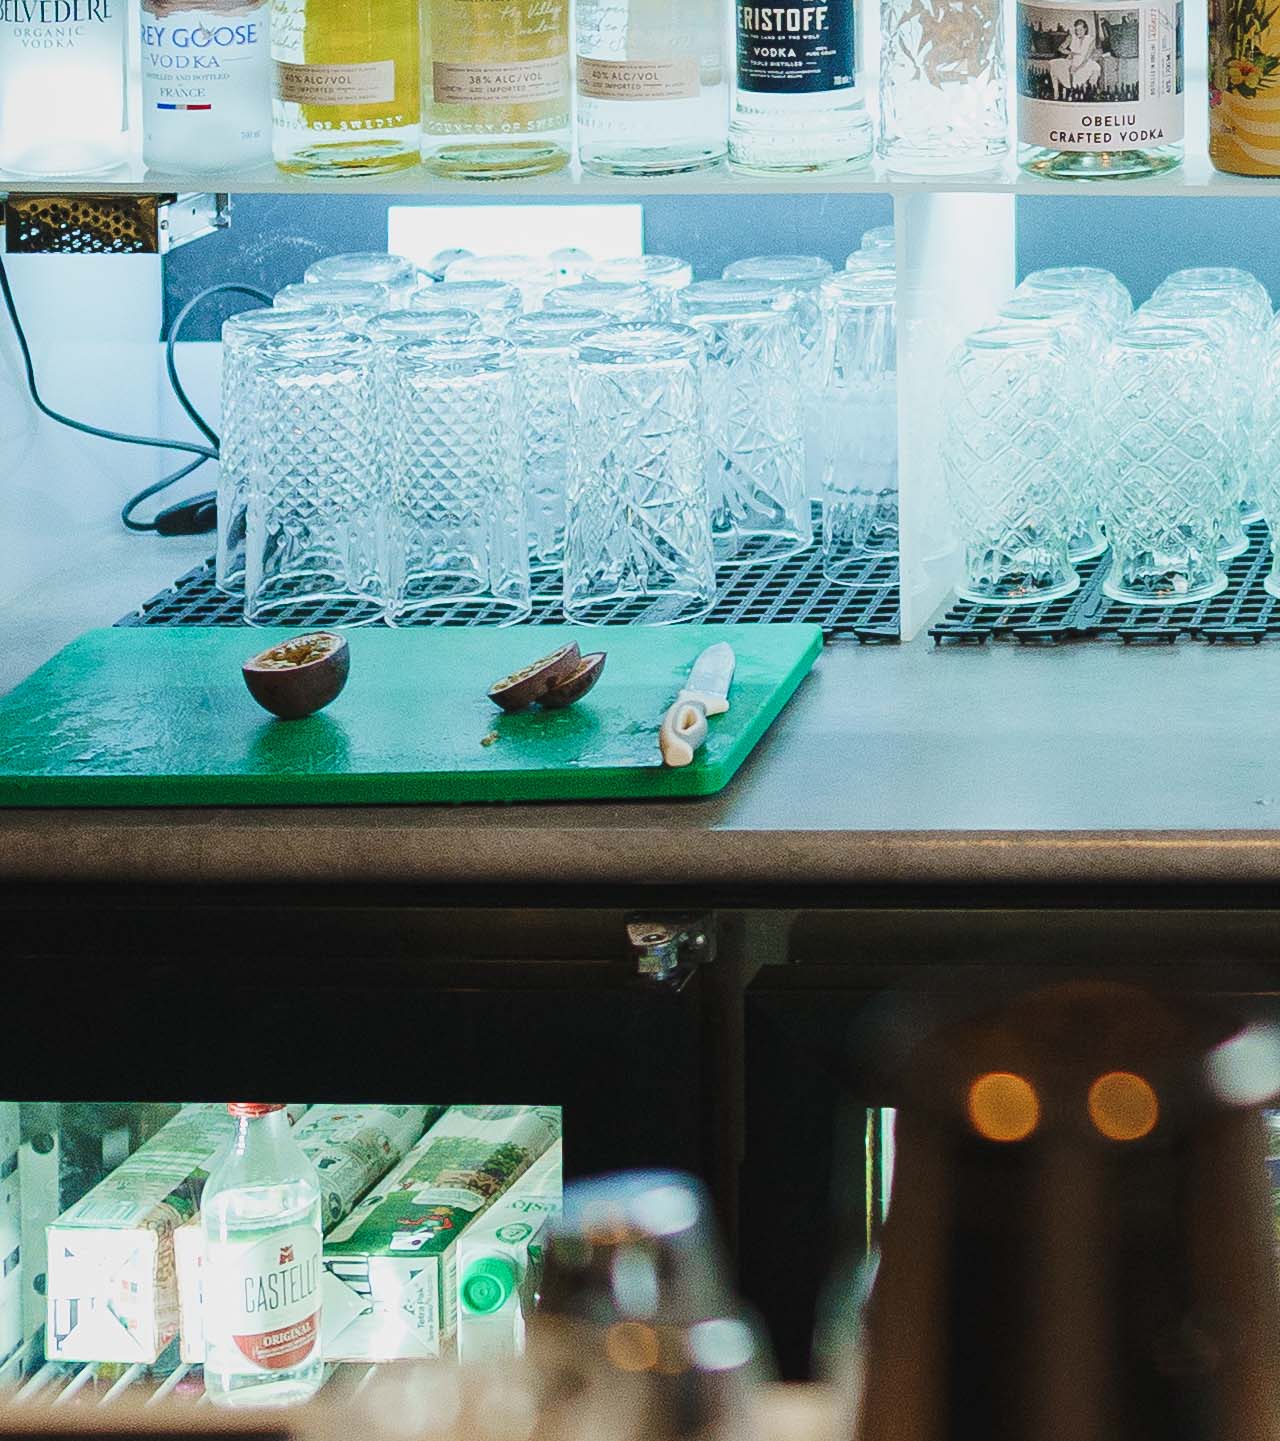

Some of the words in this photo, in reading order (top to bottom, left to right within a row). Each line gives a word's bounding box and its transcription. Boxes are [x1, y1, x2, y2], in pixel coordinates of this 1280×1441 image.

[14, 27, 85, 37] ORGANIC
[141, 24, 166, 46] REY
[172, 23, 257, 48] GOOSE
[22, 39, 76, 49] VODKA
[753, 47, 797, 59] VODKA
[149, 52, 220, 70] VODKA
[303, 75, 352, 85] ALC/VOL
[469, 75, 492, 85] 38%
[495, 72, 543, 84] ALC/VOL
[591, 70, 609, 80] 40%
[611, 71, 659, 81] ALC/VOL
[160, 87, 207, 98] FRANCE
[486, 85, 527, 93] IMPORTED
[1081, 114, 1136, 127] OBELIU
[1049, 129, 1112, 144] CRAFTED
[1118, 127, 1165, 142] VODKA
